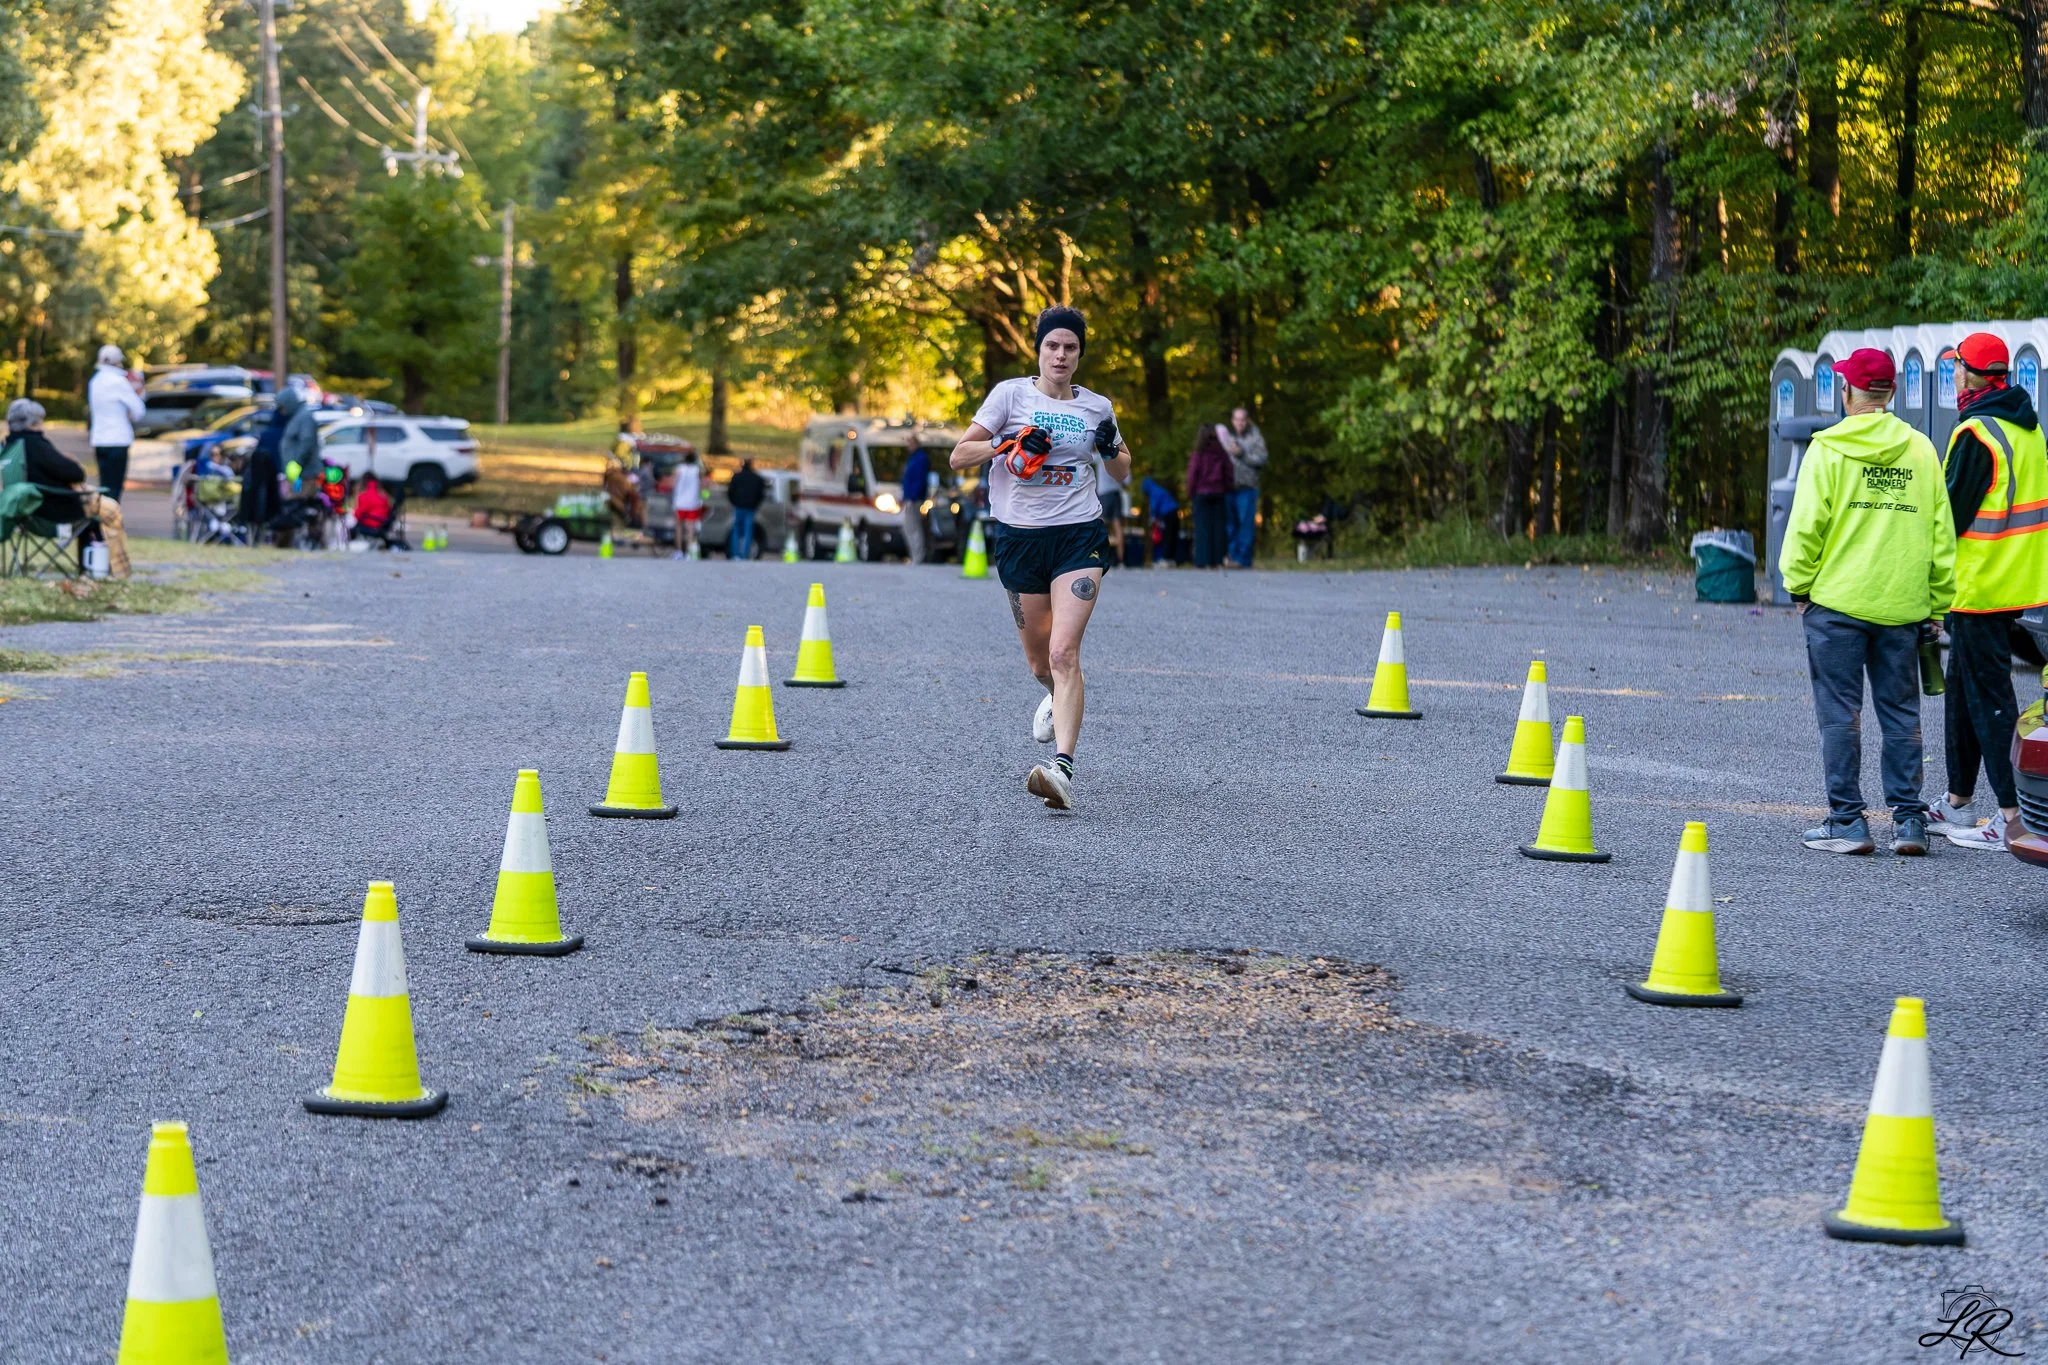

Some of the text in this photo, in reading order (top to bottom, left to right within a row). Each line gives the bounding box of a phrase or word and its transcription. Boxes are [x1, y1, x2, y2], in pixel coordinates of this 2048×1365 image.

[1034, 415, 1085, 430] CHICAGO
[1038, 423, 1082, 433] MARATHON
[1042, 471, 1073, 485] 229
[1862, 466, 1913, 480] MEMPHIS
[1867, 478, 1906, 488] RUNNERS
[1848, 501, 1918, 513] FINISH LINE CREW
[1981, 828, 1999, 840] N
